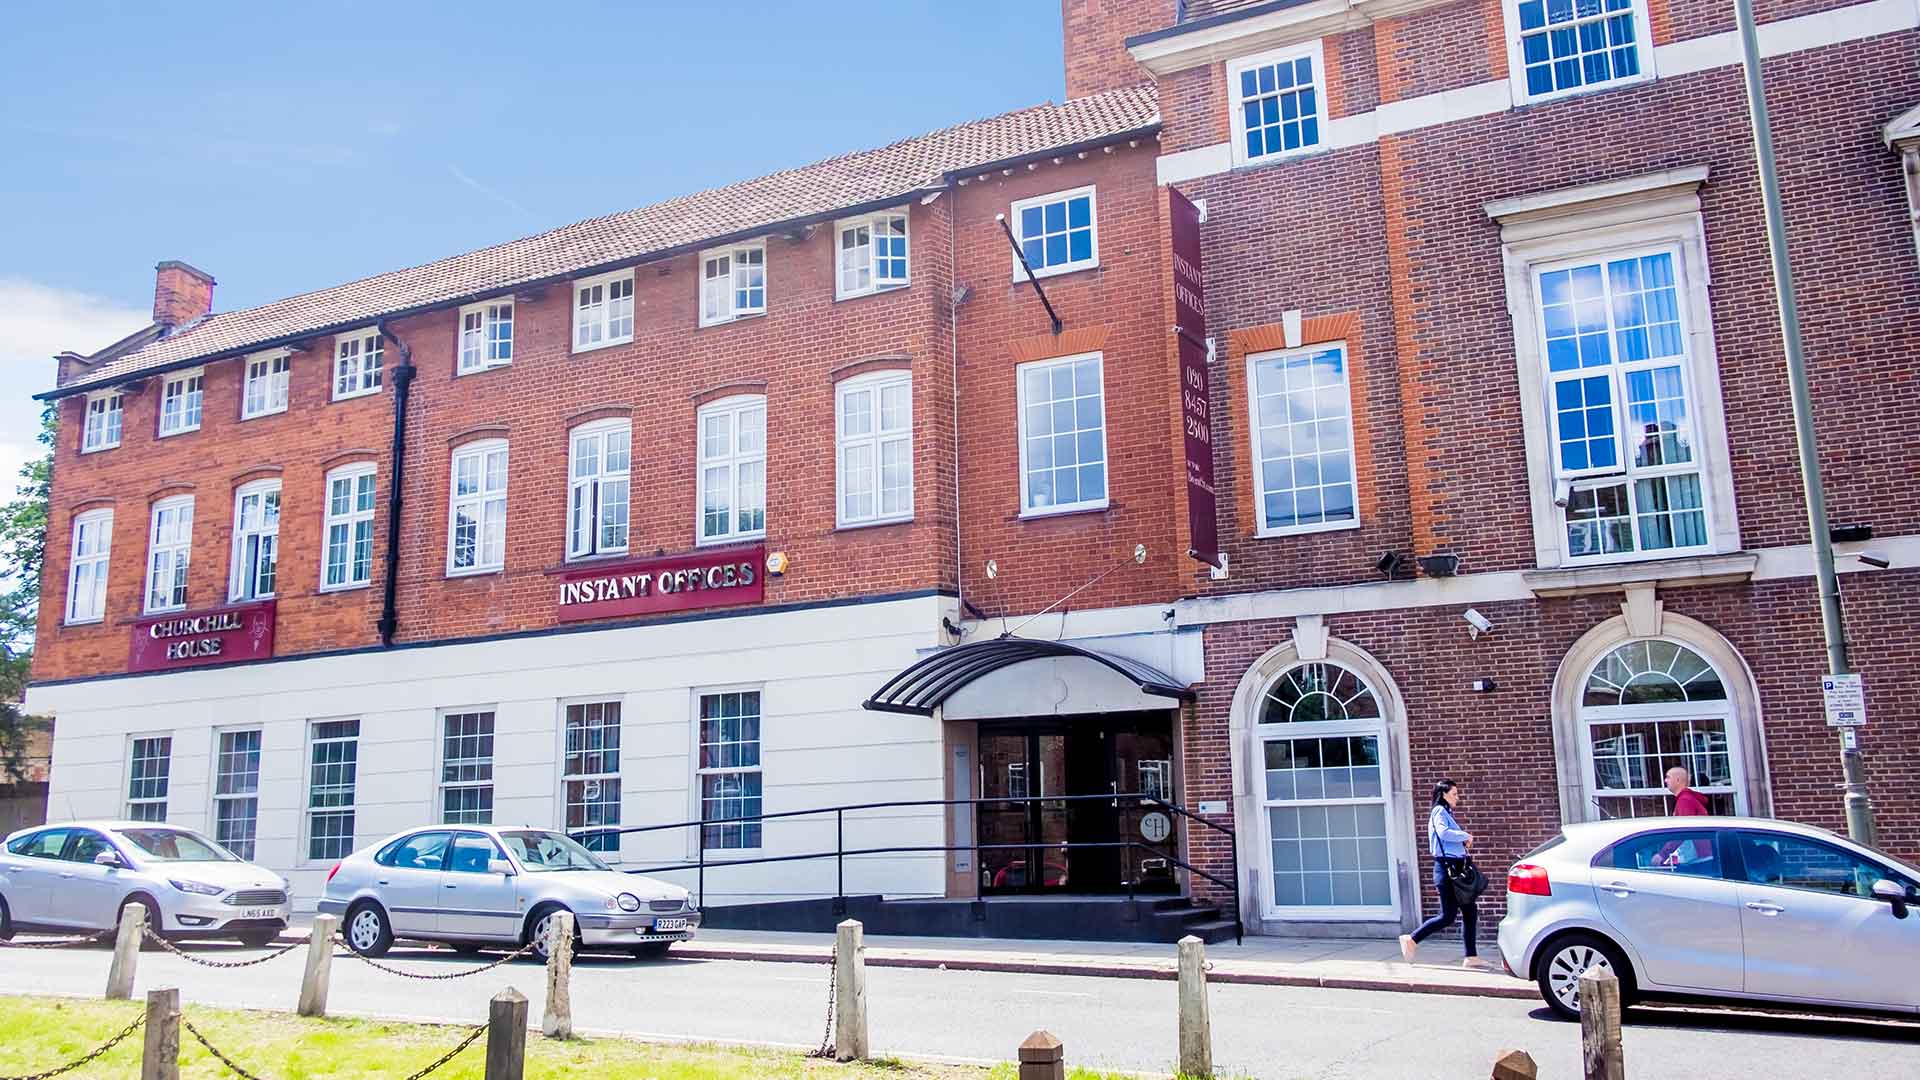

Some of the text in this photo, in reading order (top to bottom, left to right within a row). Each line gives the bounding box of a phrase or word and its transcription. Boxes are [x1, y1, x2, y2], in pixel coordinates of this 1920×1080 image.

[1174, 252, 1202, 288] INSTANT
[1176, 282, 1204, 316] OFFICES
[1186, 365, 1204, 392] 020
[1184, 389, 1207, 419] 8457
[1186, 415, 1209, 445] 2500
[559, 562, 754, 605] INSTANT OFFICES
[150, 611, 243, 640] CHURCHILL
[166, 637, 223, 660] HOUSE
[657, 919, 674, 929] R223
